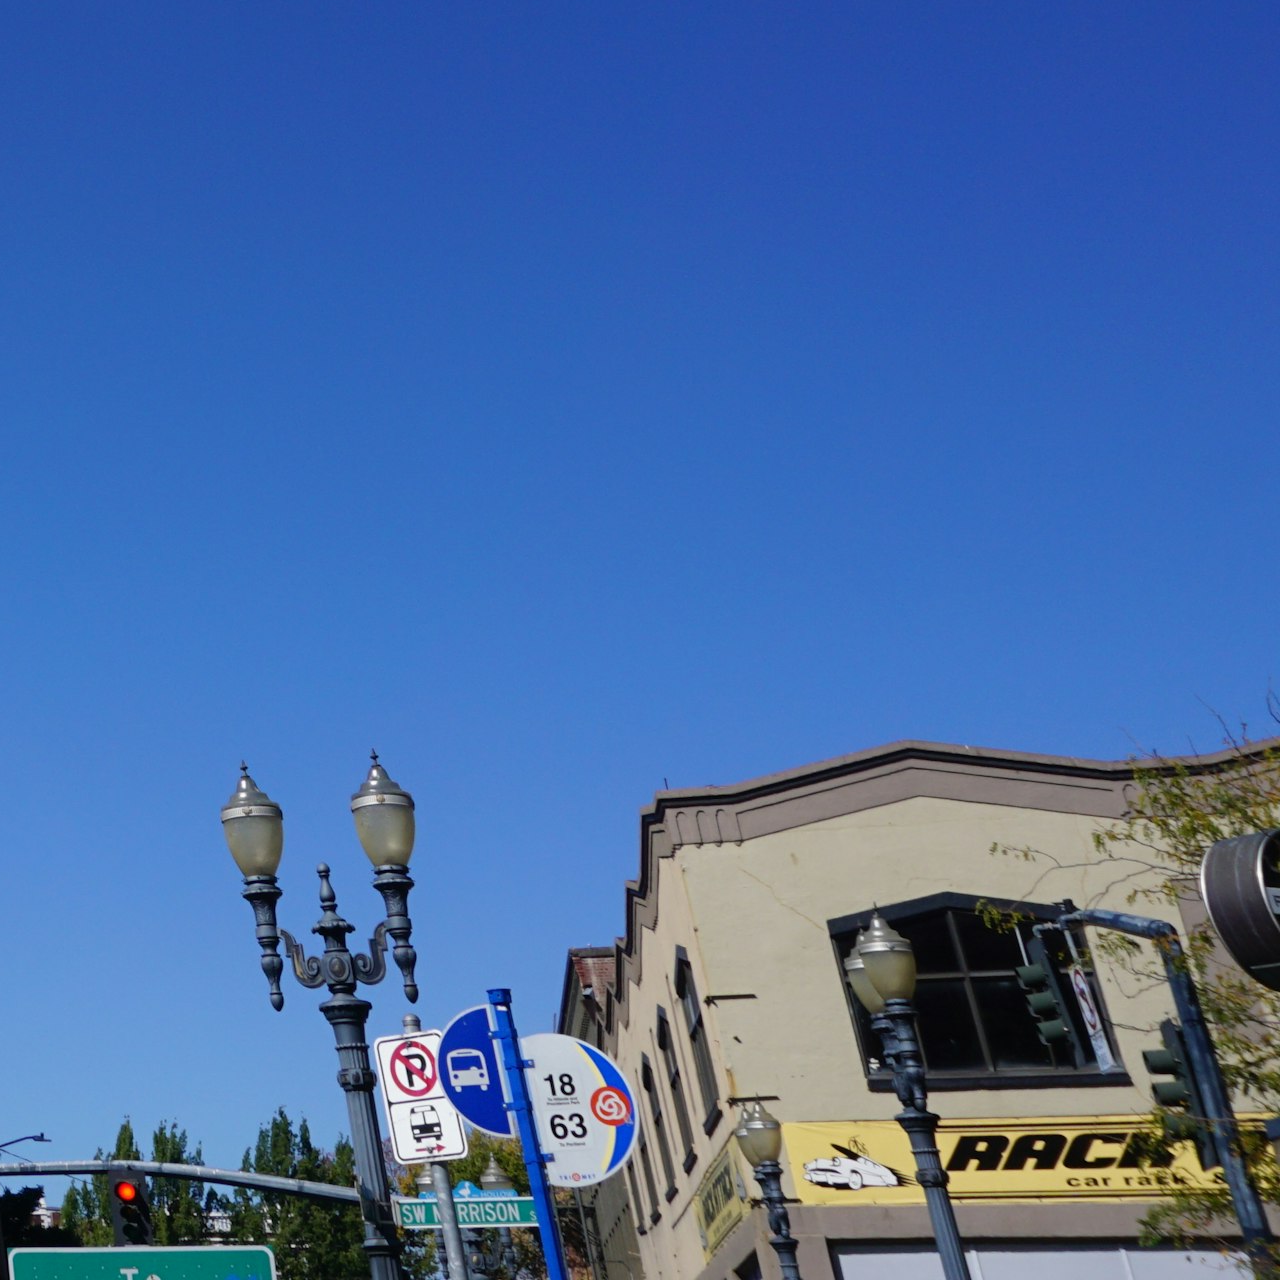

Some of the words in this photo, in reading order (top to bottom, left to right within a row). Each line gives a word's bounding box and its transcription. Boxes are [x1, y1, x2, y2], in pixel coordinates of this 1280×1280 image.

[543, 1073, 576, 1097] 18
[550, 1113, 588, 1140] 63
[946, 1132, 1178, 1171] RACK
[1066, 1174, 1111, 1188] car
[402, 1204, 426, 1223] SW
[432, 1202, 521, 1223] MRRISON
